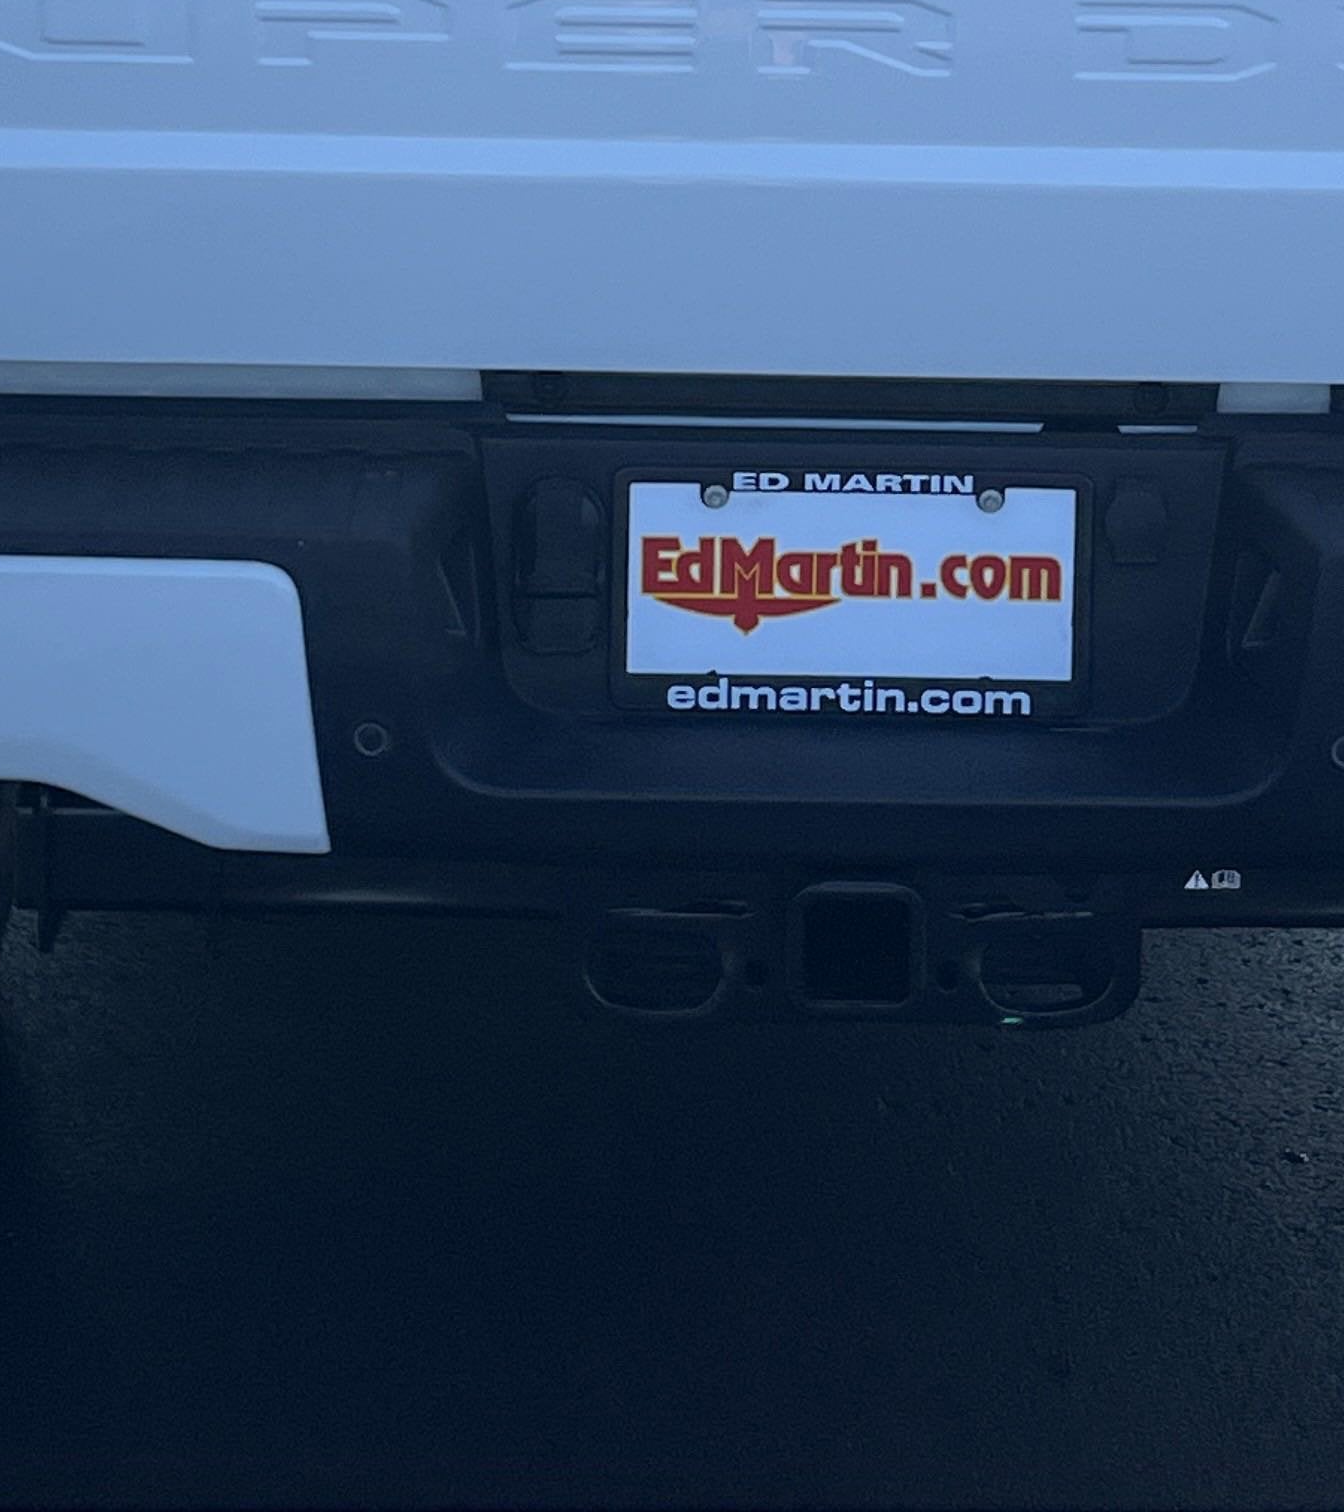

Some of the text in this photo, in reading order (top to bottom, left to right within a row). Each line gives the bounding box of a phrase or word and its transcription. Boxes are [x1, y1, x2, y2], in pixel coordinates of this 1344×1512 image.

[732, 472, 975, 494] ED MARTIN
[666, 678, 1032, 717] edmartin.com
